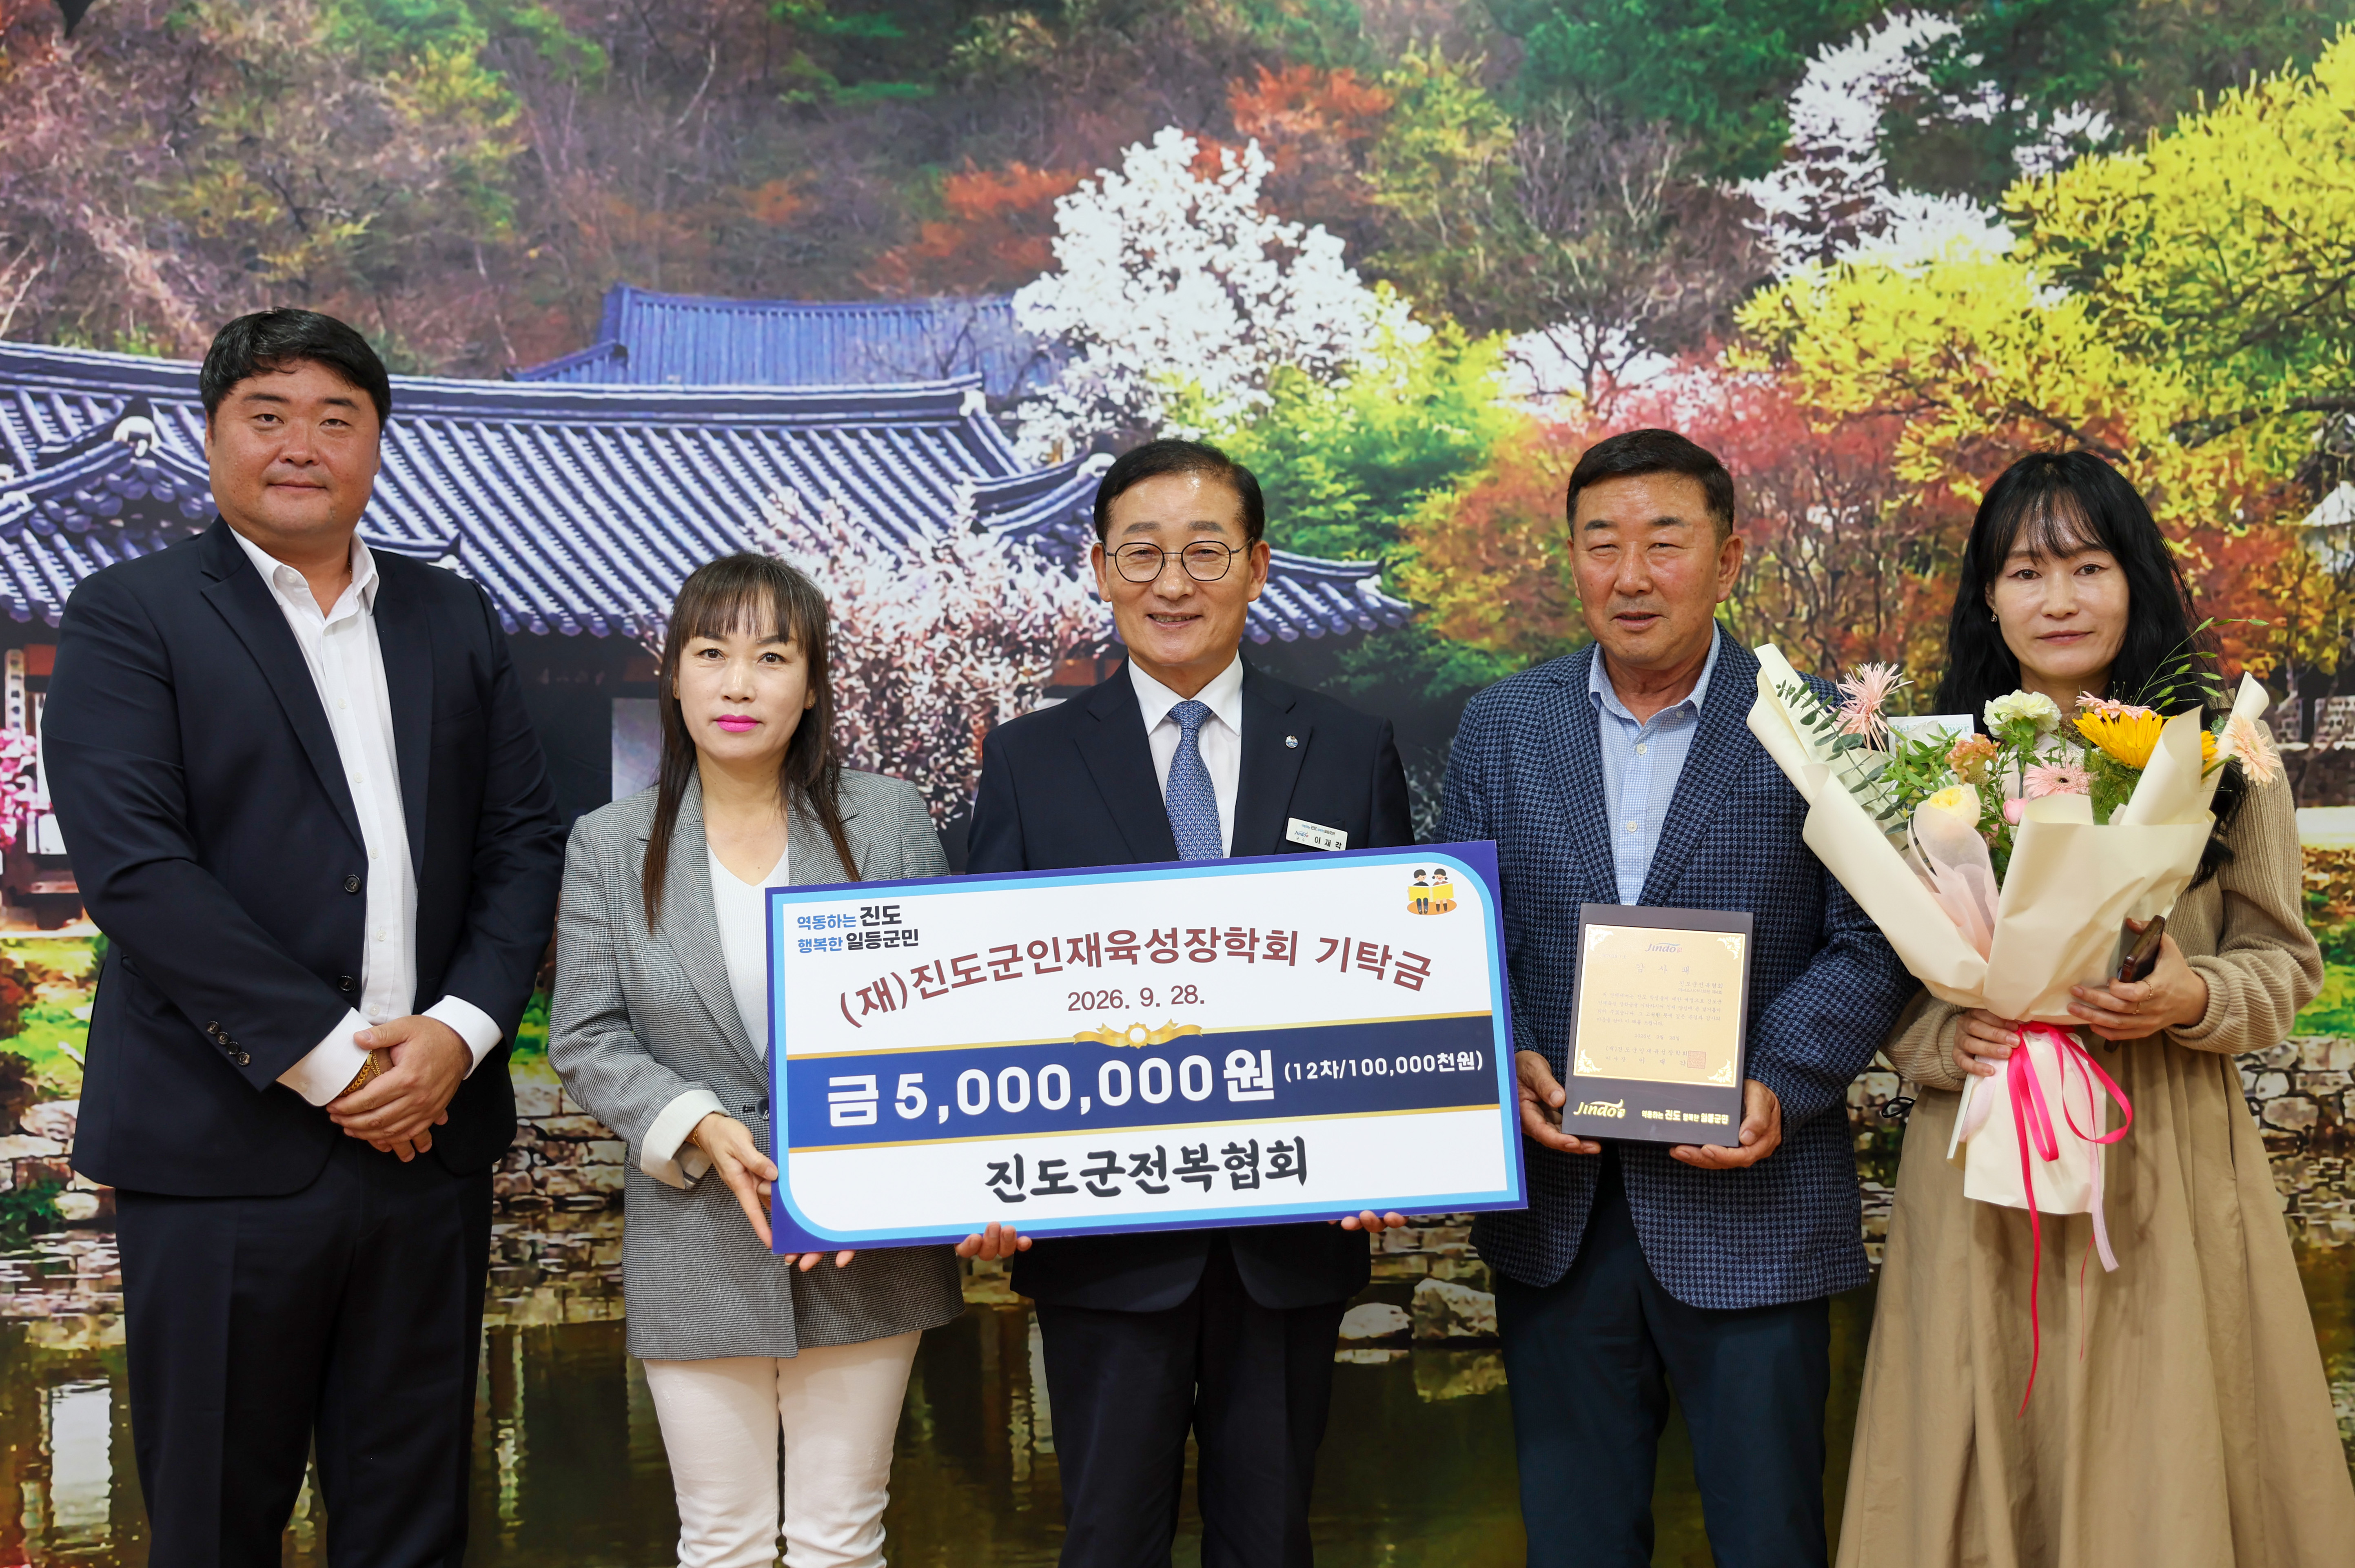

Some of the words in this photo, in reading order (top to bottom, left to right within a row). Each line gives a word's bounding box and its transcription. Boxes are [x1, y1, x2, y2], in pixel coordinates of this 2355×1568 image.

[798, 914, 856, 930] 역동하는
[860, 905, 902, 926] 진도
[798, 937, 843, 953] 행복한
[846, 929, 918, 950] 일등군민
[1645, 943, 1676, 952] Jindo
[840, 927, 1297, 1028] (재)진도군인재육성장학회
[1315, 937, 1431, 991] 기탁금
[1068, 990, 1129, 1011] 2026.
[1140, 988, 1160, 1007] 9.
[1171, 985, 1204, 1004] 28.
[1285, 1051, 1482, 1082] (12차/100,000천원)
[1573, 1101, 1618, 1118] Jindo
[1665, 1109, 1681, 1121] 진도
[985, 1136, 1307, 1203] 진도군전복협회
